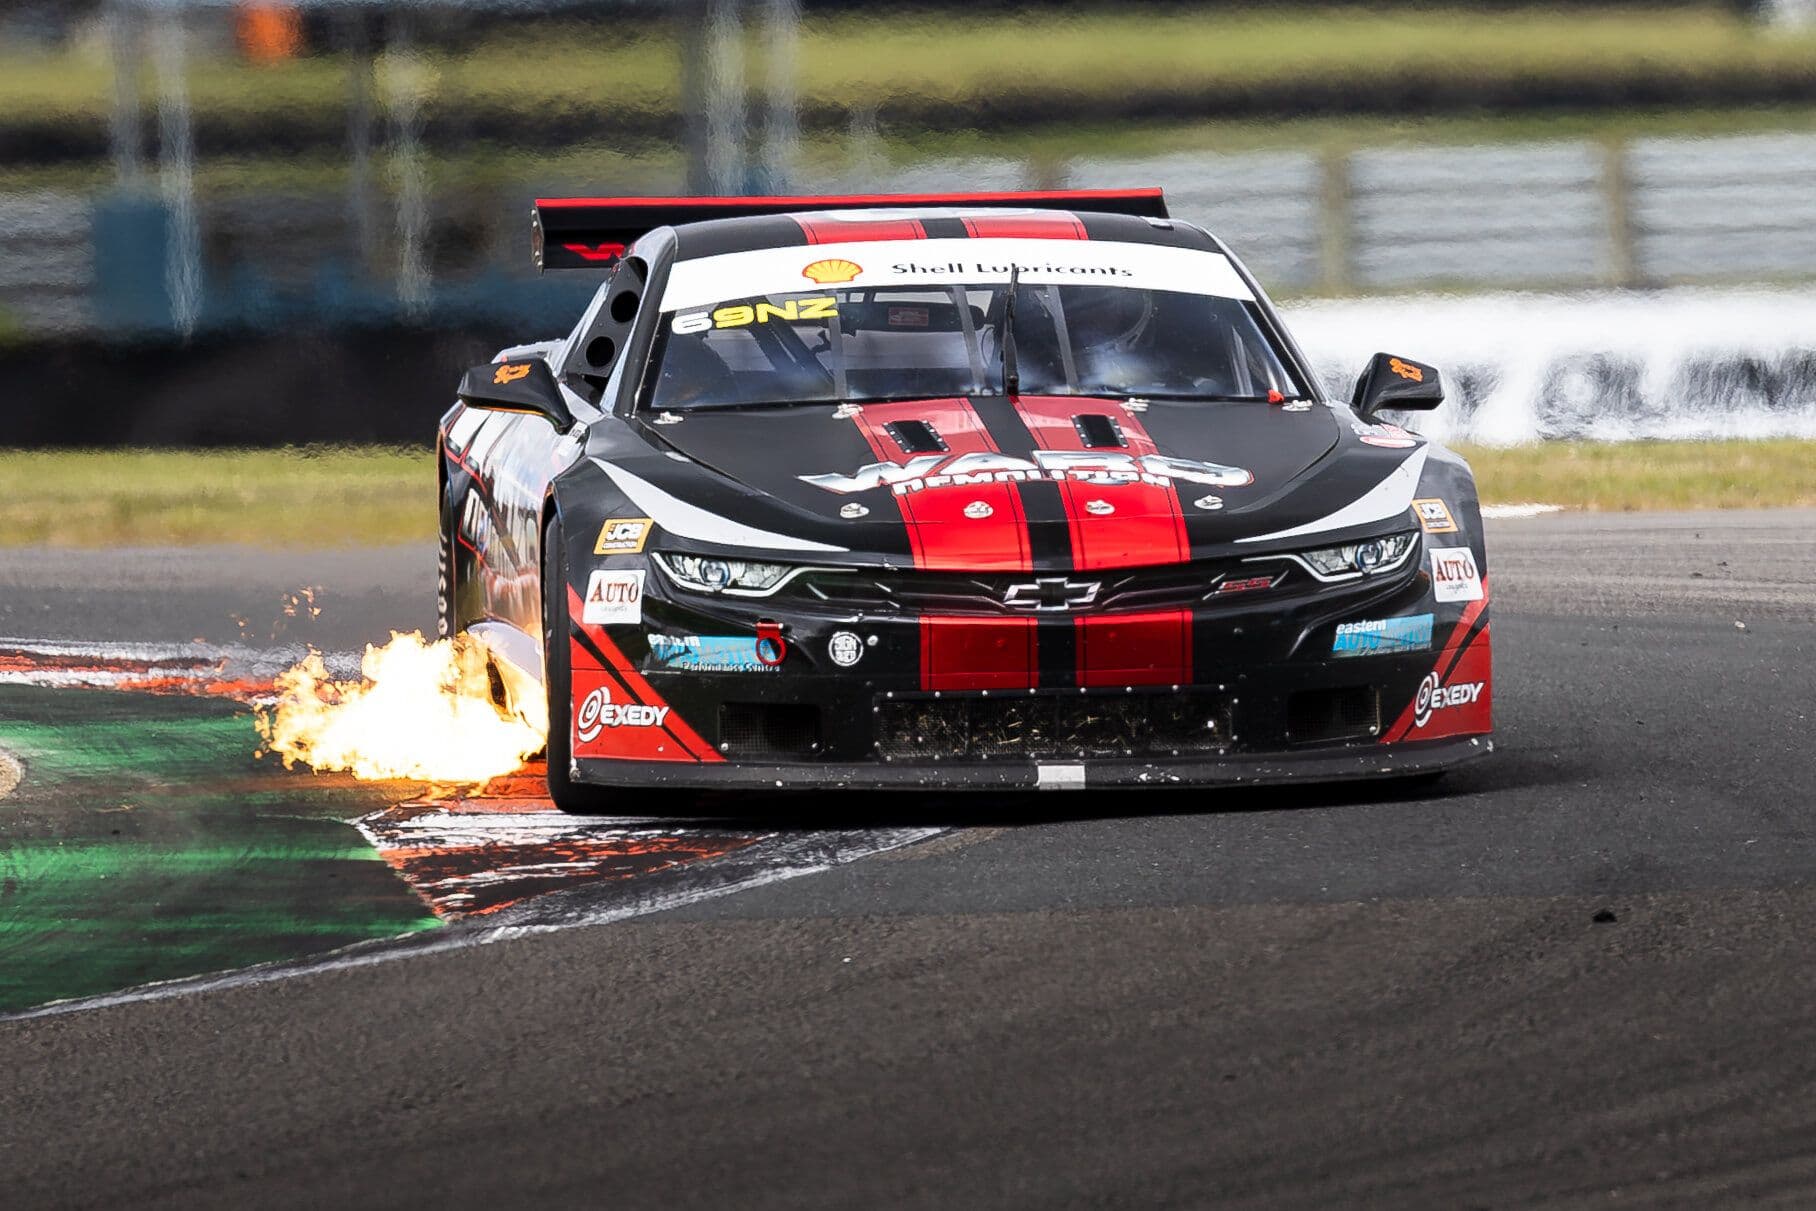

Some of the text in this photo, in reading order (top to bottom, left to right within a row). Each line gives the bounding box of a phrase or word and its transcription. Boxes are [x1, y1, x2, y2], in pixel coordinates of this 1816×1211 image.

[891, 262, 1134, 277] Shell Lubricants
[671, 296, 839, 335] 69NZ
[605, 522, 645, 541] JCB
[1436, 555, 1475, 581] AUTO
[589, 579, 639, 603] AUTO
[1335, 619, 1388, 635] eastern
[1430, 682, 1485, 709] EXEDY
[600, 703, 670, 727] EXEDY
